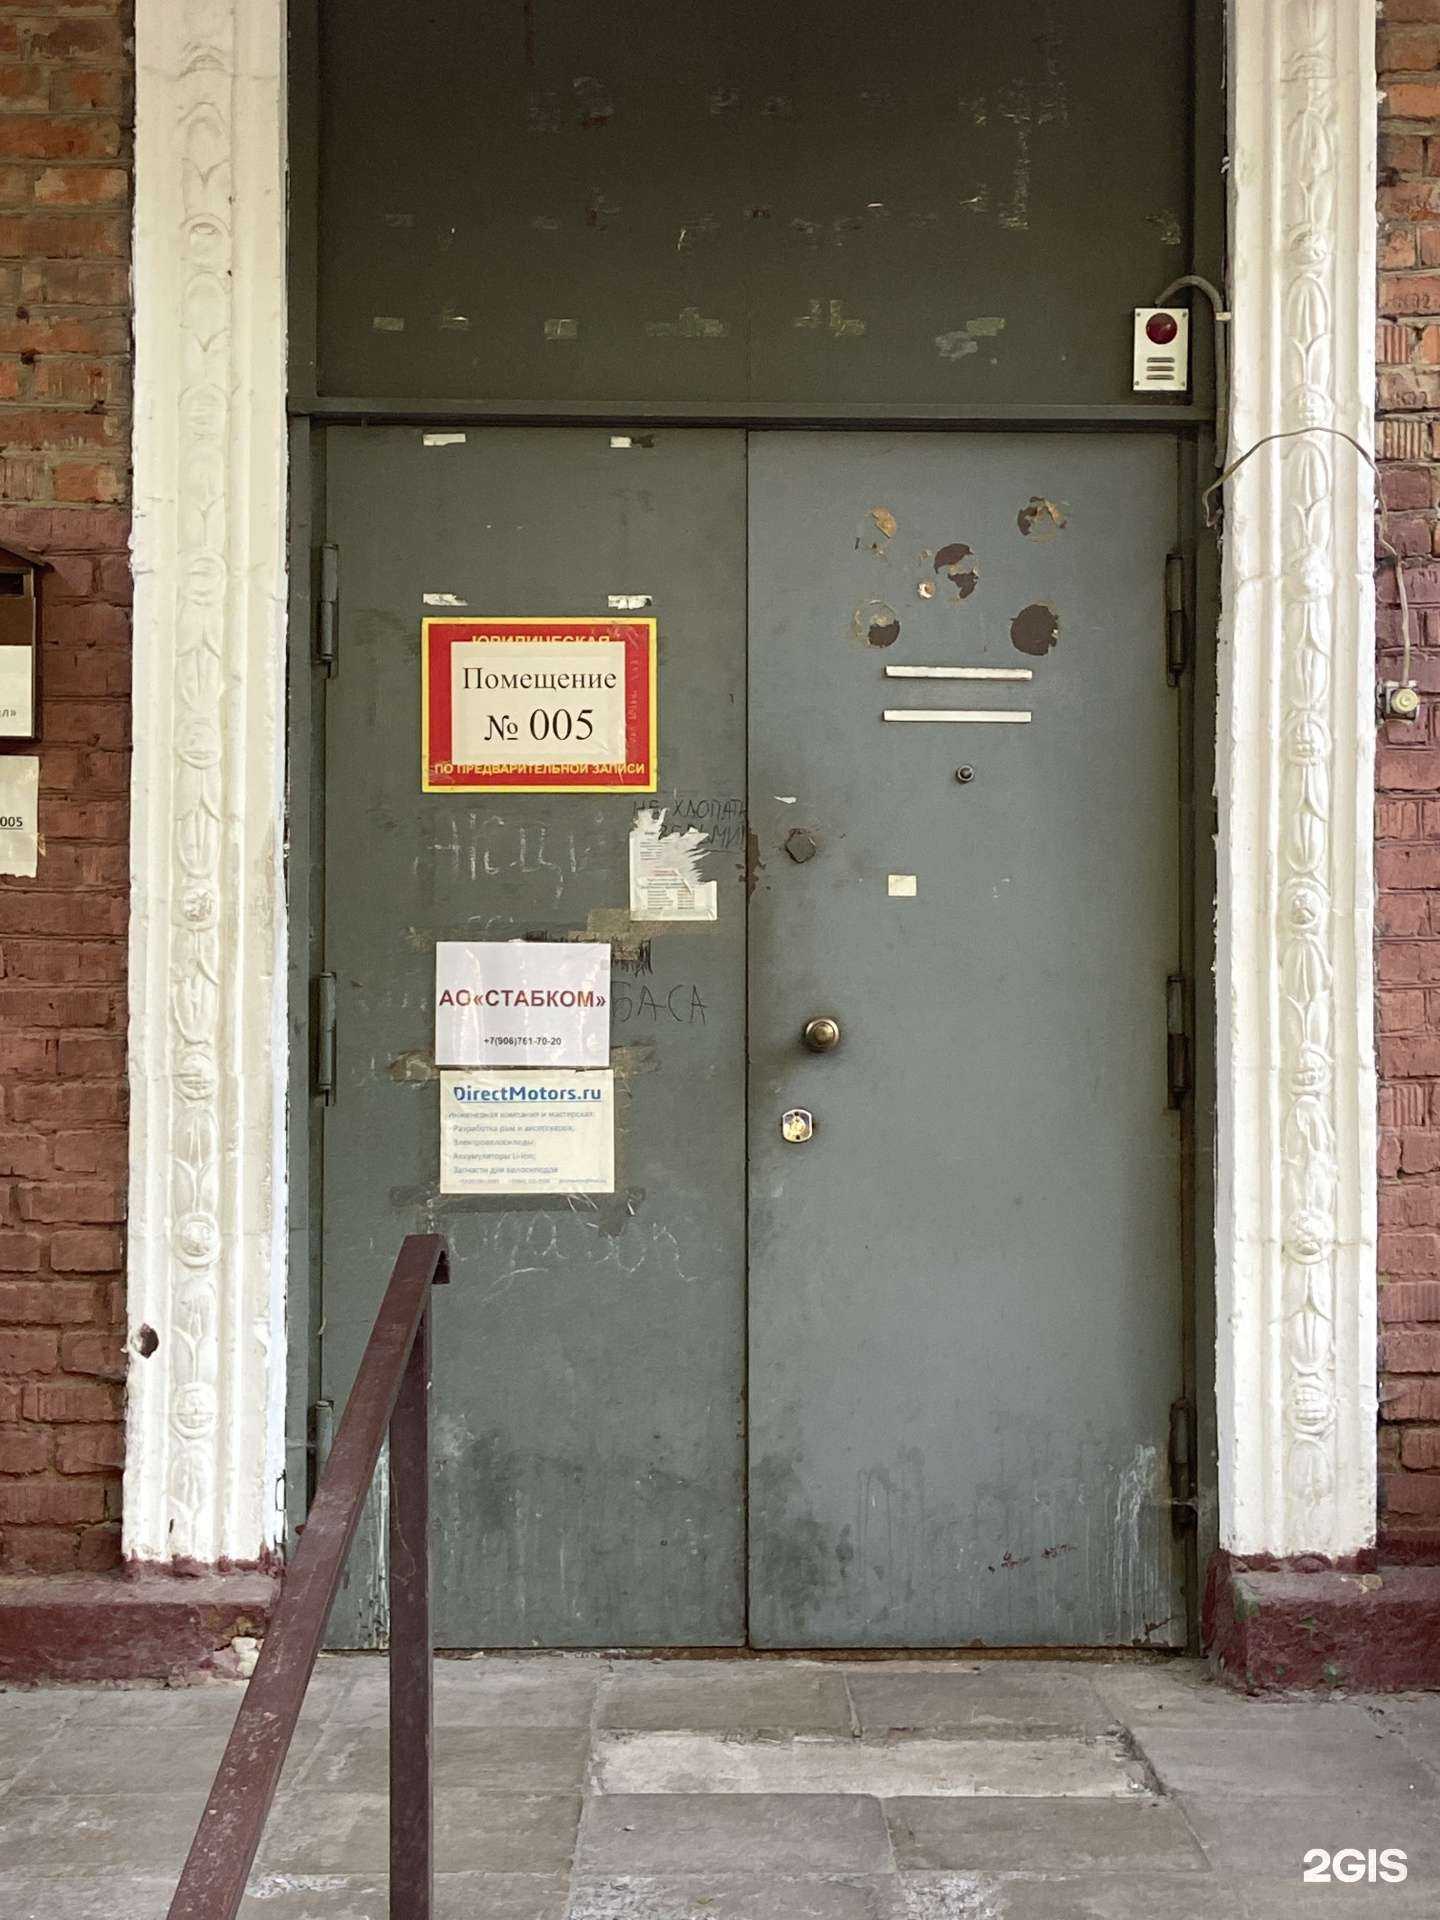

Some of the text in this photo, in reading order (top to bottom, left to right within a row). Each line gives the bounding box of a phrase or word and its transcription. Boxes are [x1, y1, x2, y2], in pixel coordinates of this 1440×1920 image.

[463, 667, 617, 691] Помещение
[484, 708, 593, 740] № 005
[435, 763, 453, 774] ПО
[591, 763, 645, 774] ЗАПИСИ
[453, 1085, 601, 1102] DirectMotors.ru
